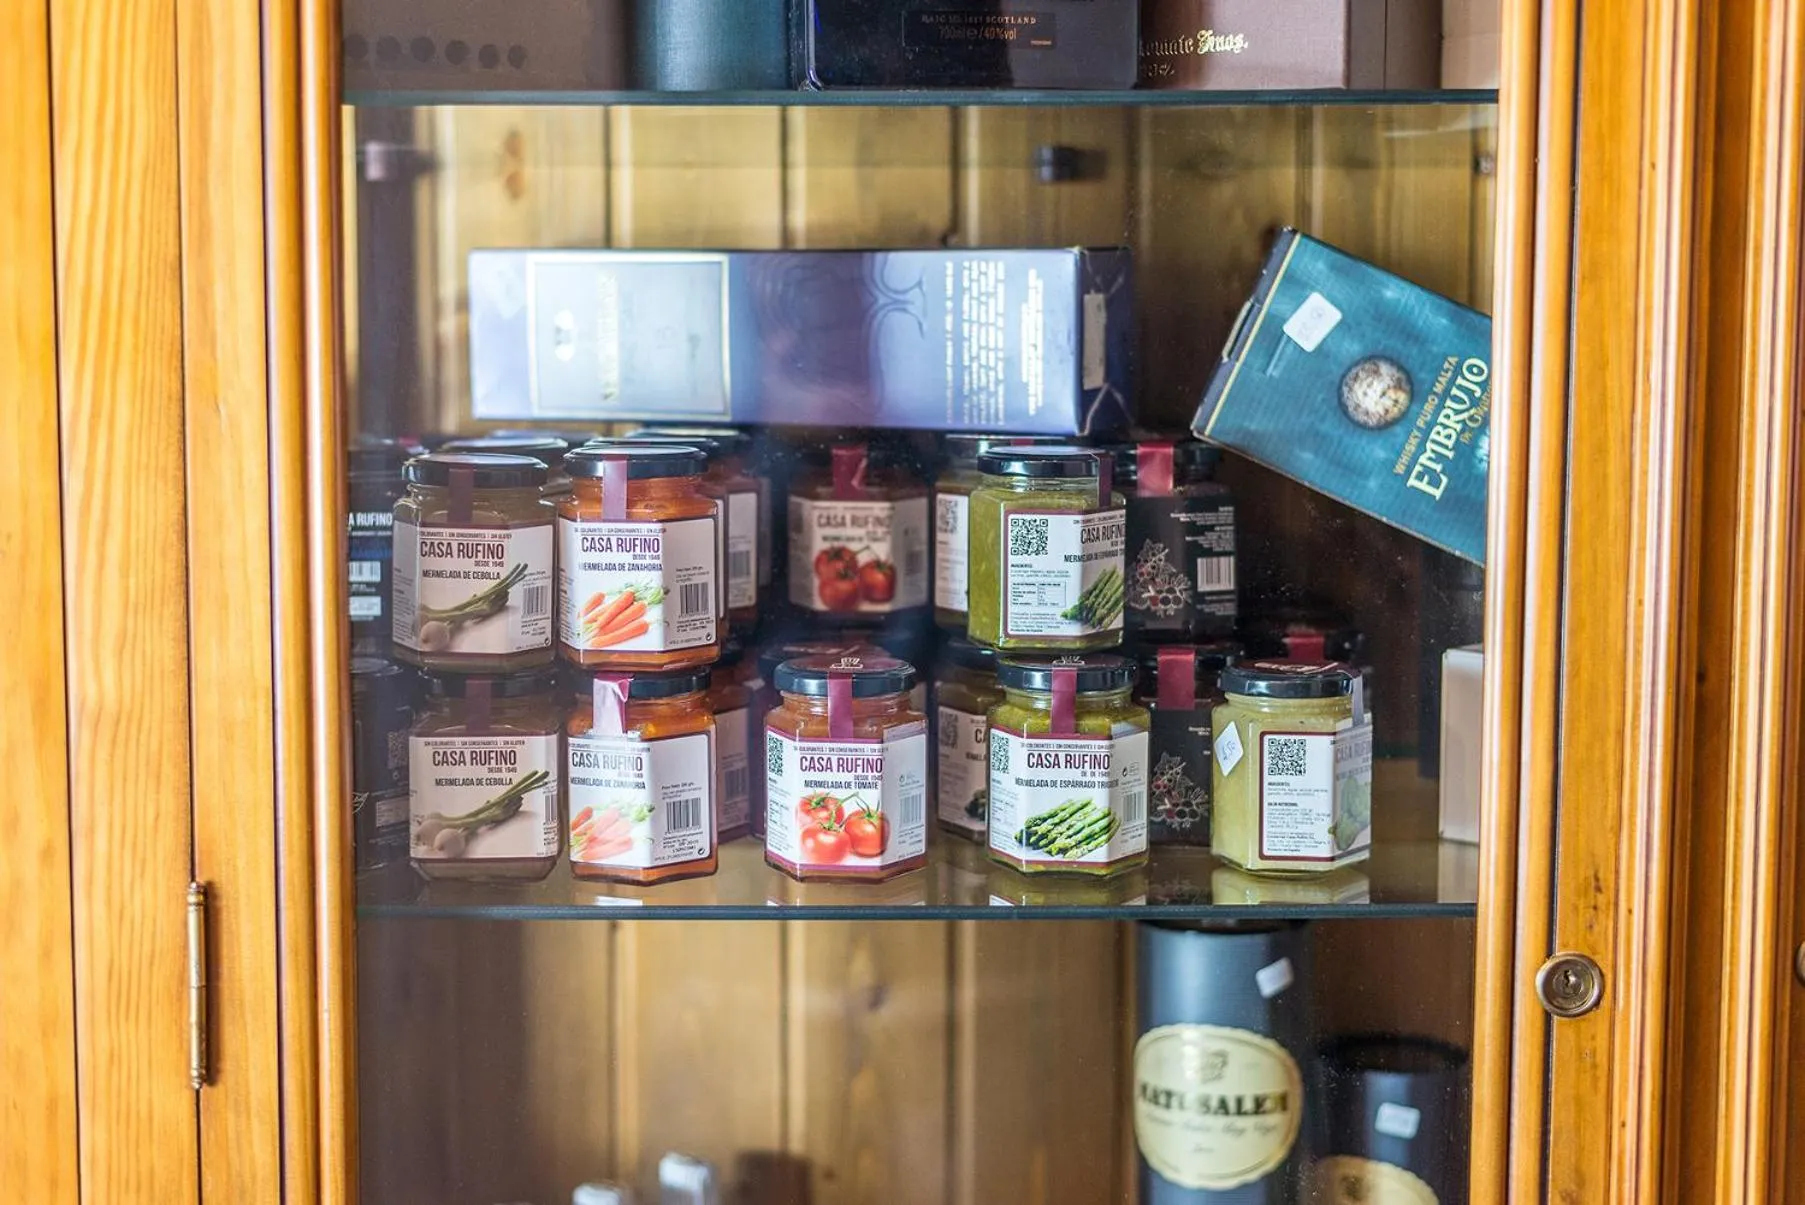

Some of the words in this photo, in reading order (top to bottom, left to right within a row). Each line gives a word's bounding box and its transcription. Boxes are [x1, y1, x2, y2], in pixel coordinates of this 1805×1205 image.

[986, 16, 1037, 25] SCOTLAND
[1392, 429, 1423, 475] WHISKY
[1416, 395, 1439, 429] PURO
[1433, 355, 1460, 394] MALTA
[1406, 357, 1489, 501] EMBRUJO
[356, 511, 394, 527] RUFINO
[817, 512, 846, 528] CASA
[1081, 526, 1101, 545] CASA
[420, 540, 454, 559] CASA
[457, 541, 504, 560] RUFINO
[581, 537, 613, 553] CASA
[616, 537, 660, 553] RUFINO
[422, 569, 462, 580] MERMELADA
[463, 569, 472, 580] DE
[473, 570, 500, 580] CEBOLLA
[618, 562, 626, 572] DE
[627, 563, 663, 572] ZANAHORIA
[432, 750, 467, 766] CASA
[470, 749, 517, 766] RUFINO
[572, 752, 600, 769] CASA
[602, 754, 643, 772] RUFINO
[800, 756, 834, 773] CASA
[837, 757, 883, 774] RUFINO
[1027, 752, 1061, 769] CASA
[1064, 753, 1110, 770] RUFINO
[434, 777, 475, 787] MERMELADA
[475, 777, 485, 786] DE
[485, 777, 513, 786] CEBOLLA
[803, 779, 843, 789] MERMELADA
[844, 780, 852, 789] DE
[853, 780, 879, 790] TOMATE
[1049, 779, 1058, 788] DE
